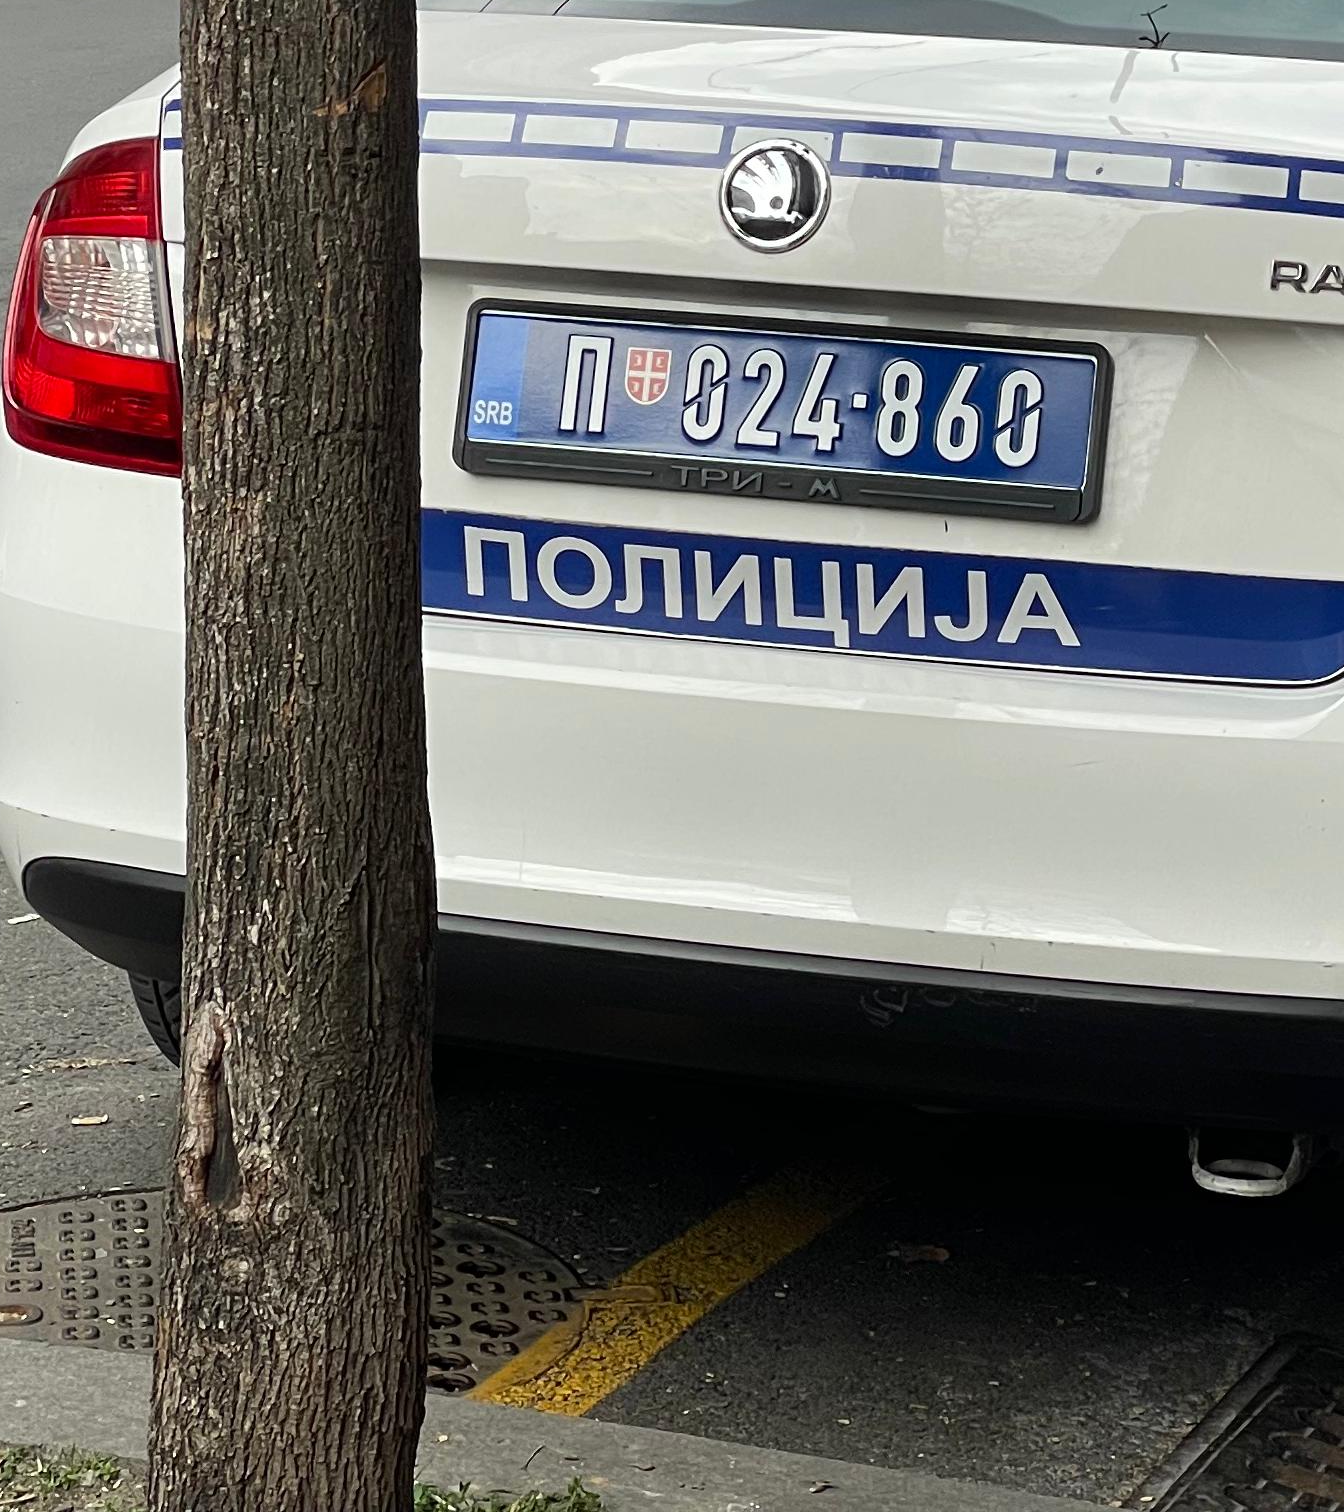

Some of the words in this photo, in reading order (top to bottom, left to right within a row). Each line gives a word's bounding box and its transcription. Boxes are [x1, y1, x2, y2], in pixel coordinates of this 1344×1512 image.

[473, 400, 513, 426] SRB
[559, 334, 614, 433] П
[670, 464, 764, 494] ТРИ
[462, 525, 1082, 648] ПОЛИЦИЈА
